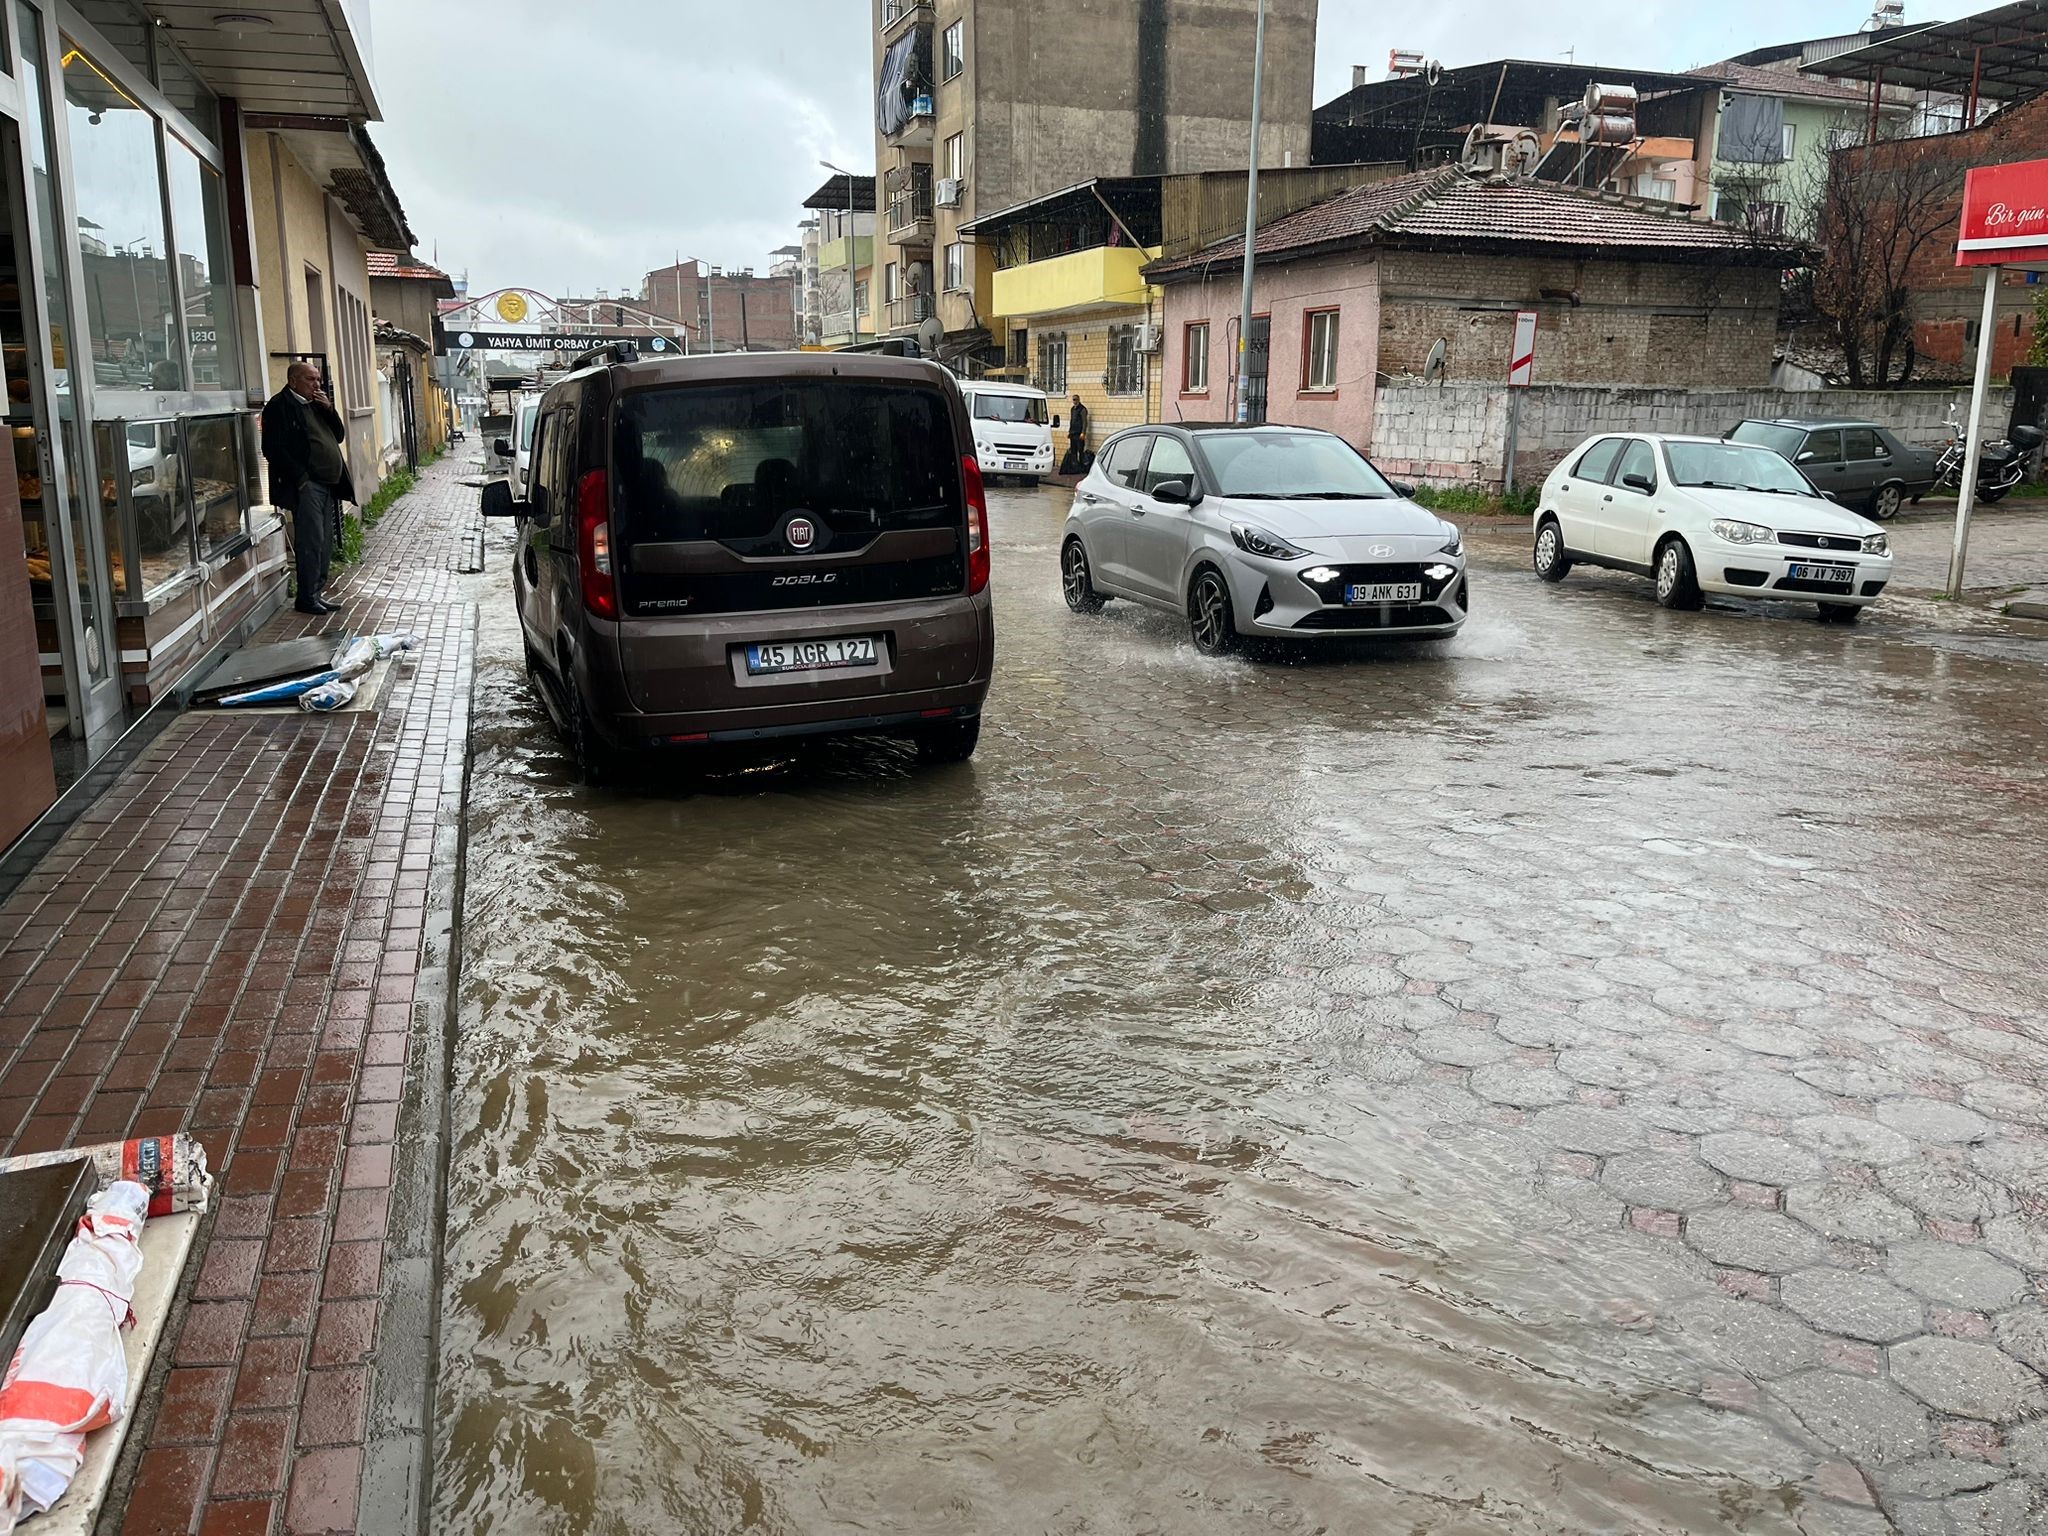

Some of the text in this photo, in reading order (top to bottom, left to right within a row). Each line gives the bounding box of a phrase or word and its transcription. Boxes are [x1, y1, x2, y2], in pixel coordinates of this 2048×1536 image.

[1985, 202, 2045, 228] Bir gün
[488, 337, 523, 348] YAHYA
[525, 336, 551, 349] ÜMİT
[554, 338, 590, 350] ORBAY
[792, 527, 809, 541] FIAT
[772, 573, 837, 586] DOBLO
[1796, 566, 1852, 581] 06 AV 7997
[1353, 586, 1366, 600] 09
[1371, 586, 1393, 600] ANK
[1397, 585, 1417, 599] 631
[760, 647, 786, 666] 45
[793, 643, 830, 663] AGR
[836, 640, 870, 661] 127
